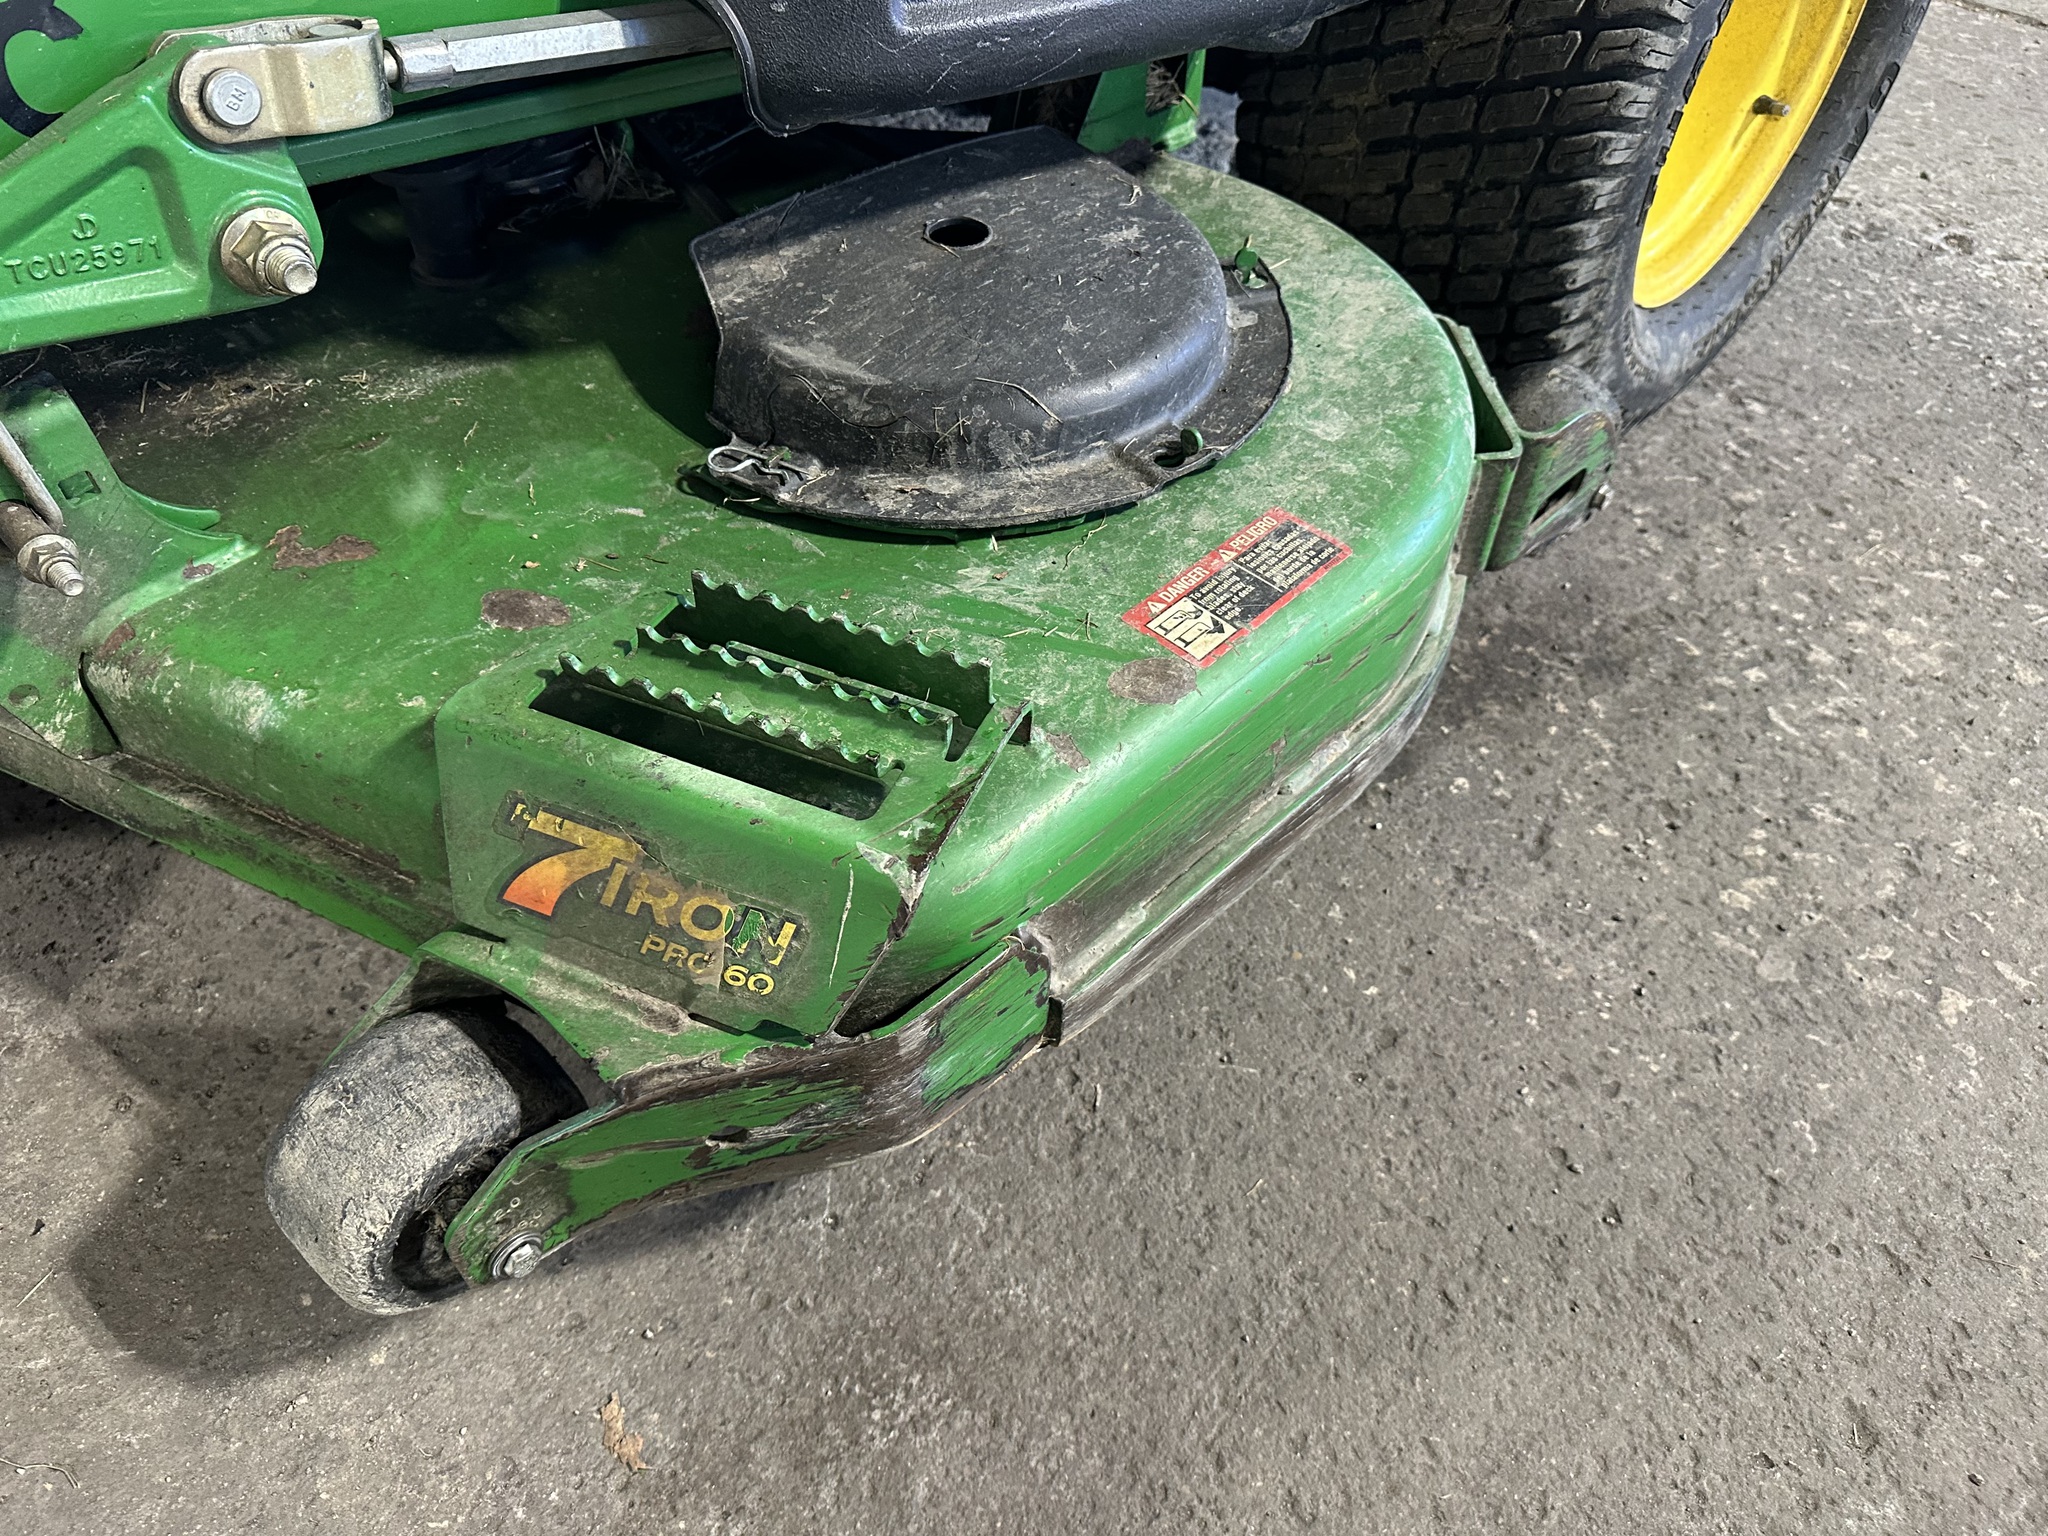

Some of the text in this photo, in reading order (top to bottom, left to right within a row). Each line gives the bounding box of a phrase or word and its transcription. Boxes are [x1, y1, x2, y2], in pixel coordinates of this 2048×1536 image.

[3, 235, 162, 284] TCU25971
[1230, 516, 1278, 551] PELIGRO
[1238, 538, 1273, 563] Para evitar
[1246, 548, 1275, 568] lesiones
[1255, 563, 1270, 574] por
[1265, 556, 1278, 565] las
[1262, 551, 1300, 578] mantenerse
[1295, 535, 1321, 554] alejado
[1271, 573, 1285, 582] del
[1281, 560, 1302, 575] borde
[1298, 554, 1310, 562] de
[1279, 562, 1315, 588] plataforma
[1308, 556, 1321, 565] de
[1159, 566, 1210, 602] DANGER
[1188, 591, 1202, 600] To
[1197, 578, 1219, 593] avoid
[1197, 574, 1241, 605] from rotating
[1213, 584, 1255, 615] clear of deck
[1228, 581, 1246, 593] stay
[1222, 604, 1245, 621] edge.
[503, 803, 797, 965] 7 IRON
[723, 965, 774, 997] 60
